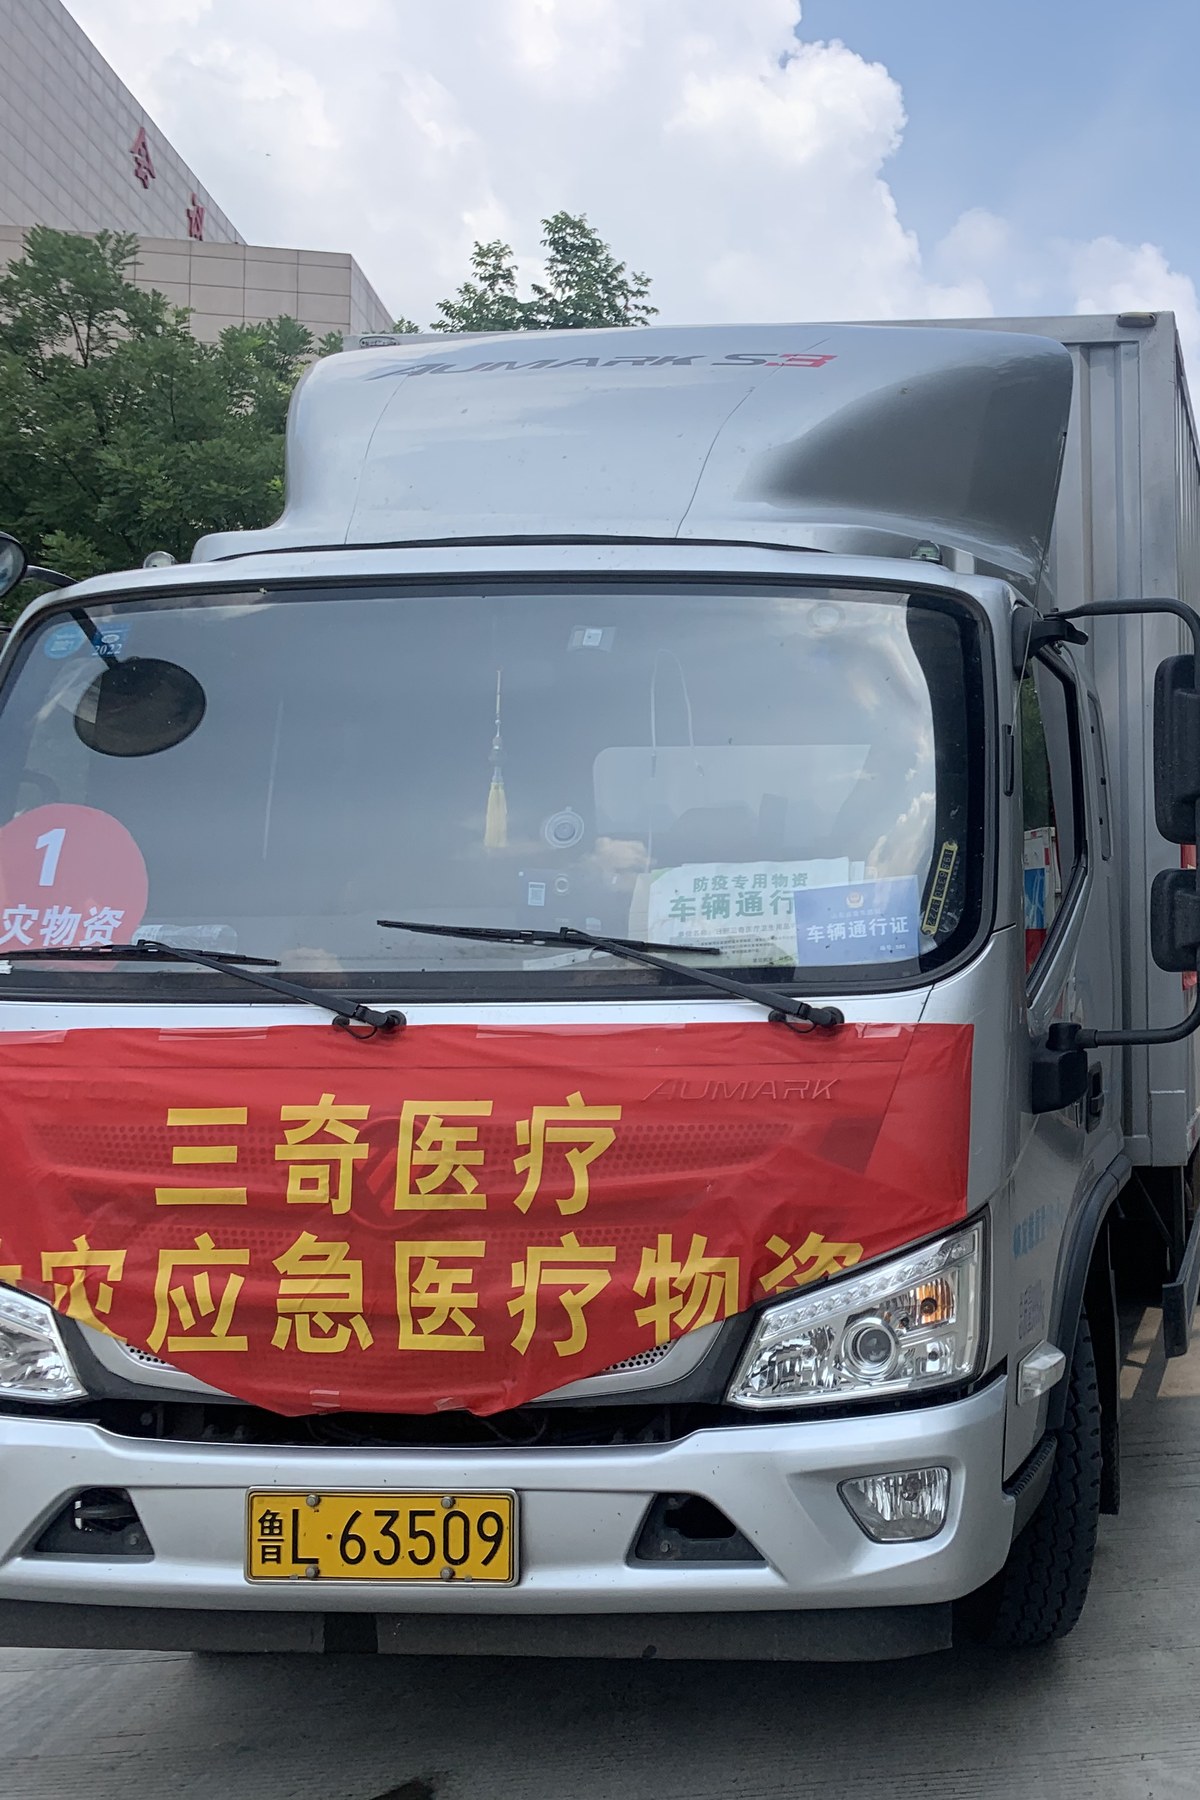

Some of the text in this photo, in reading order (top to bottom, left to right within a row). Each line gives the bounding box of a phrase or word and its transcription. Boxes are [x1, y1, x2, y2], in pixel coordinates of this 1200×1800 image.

[365, 353, 838, 381] AUMARK S3
[92, 644, 122, 656] 2022
[35, 828, 66, 886] 1
[693, 873, 808, 893] 防疫专用物资
[0, 904, 125, 947] 灾物资
[806, 916, 909, 943] 车辆通行证
[643, 1078, 841, 1100] AUMARK
[154, 1091, 625, 1216] 三奇医疗
[0, 1232, 864, 1357] 灾应急医疗物资
[257, 1509, 505, 1567] 鲁L·63509
